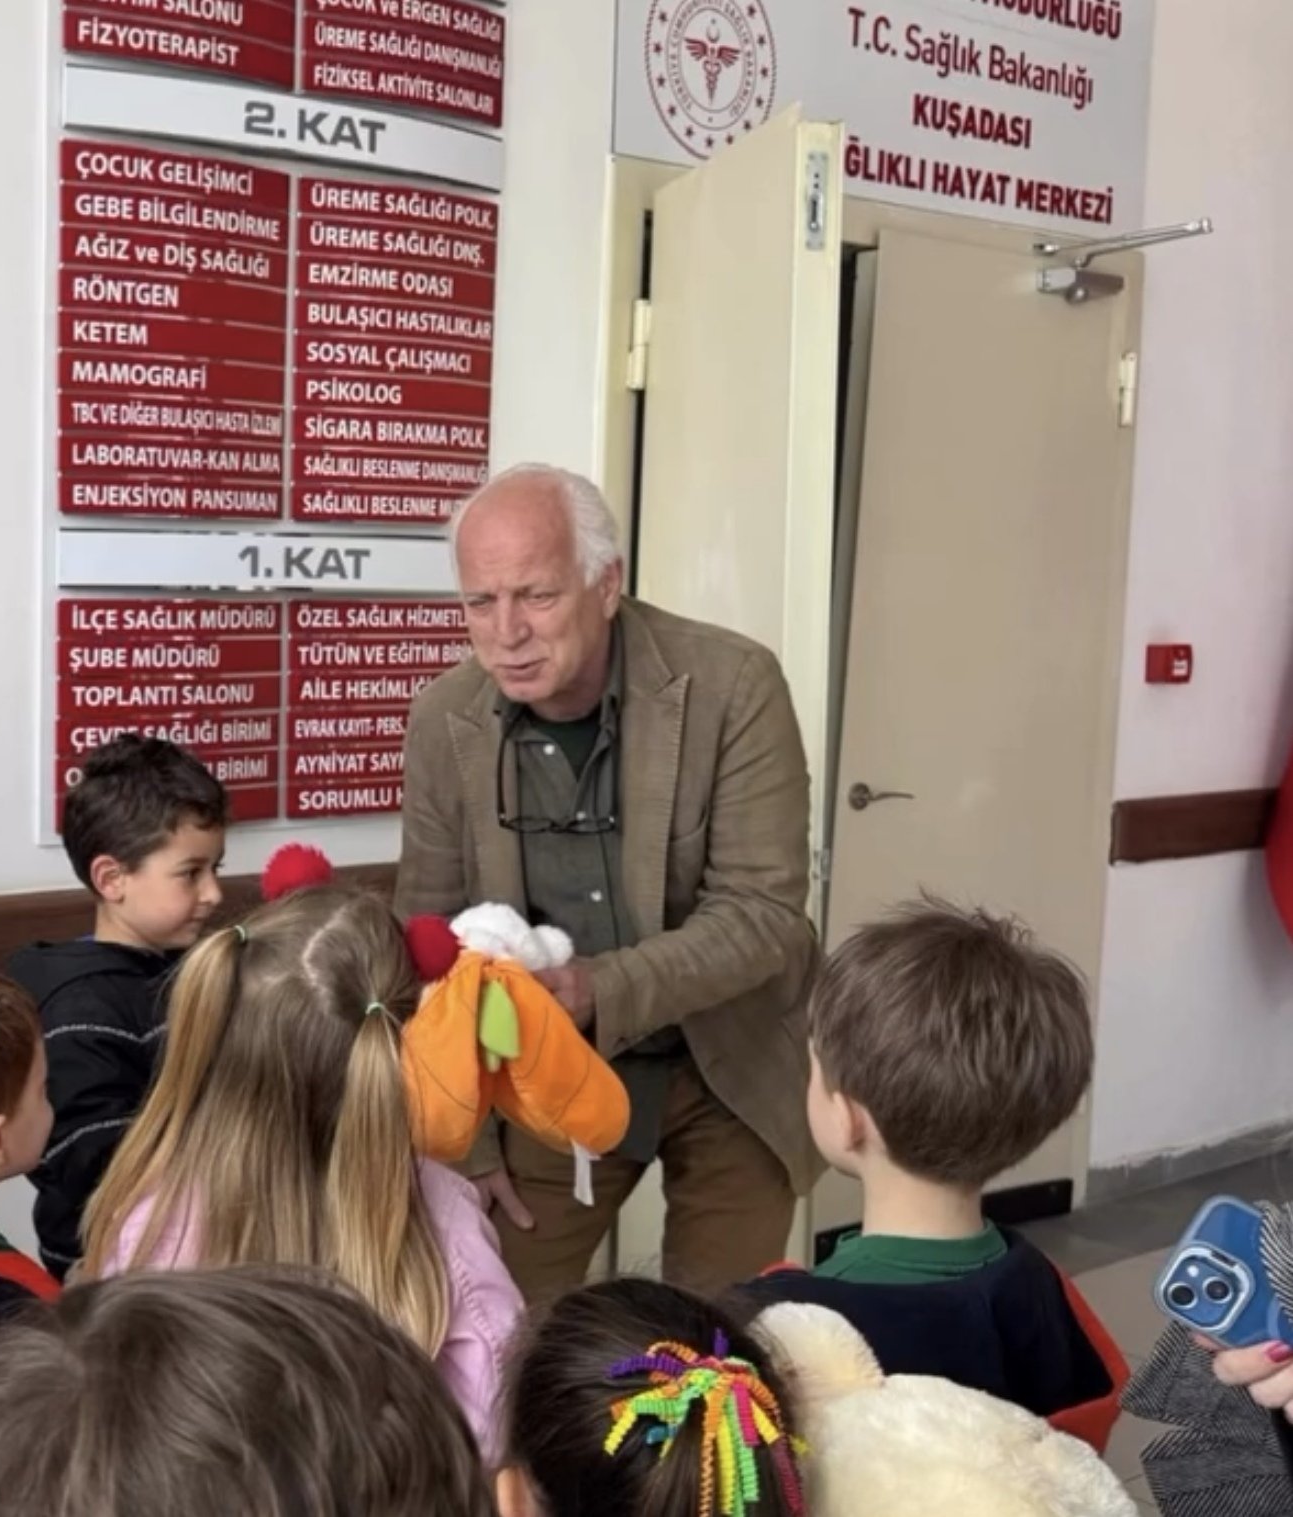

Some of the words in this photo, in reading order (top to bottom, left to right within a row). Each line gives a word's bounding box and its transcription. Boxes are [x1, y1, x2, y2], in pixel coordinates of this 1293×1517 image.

[163, 0, 244, 27] SALONU
[380, 0, 399, 18] ve
[402, 0, 450, 28] ERGEN
[453, 10, 501, 42] SAĞLIĞI
[982, 0, 1122, 40] DÜRLÜĞÜ
[77, 17, 240, 67] FİZYOTERAPİST
[314, 21, 366, 52] ÜREME
[369, 30, 422, 60] SAĞLIĞI
[848, 8, 897, 56] T.C.
[904, 24, 981, 78] Sağlık
[988, 44, 1094, 110] Bakanlığı
[313, 61, 374, 92] FİZİKSEL
[376, 72, 434, 101] AKTİVİTE
[243, 101, 286, 138] 2.
[296, 109, 387, 154] KAT
[912, 93, 1033, 149] KUŞADASI
[75, 151, 155, 181] ÇOCUK
[159, 161, 253, 196] GELİŞİMCİ
[843, 135, 927, 191] ĞLIKLI
[932, 161, 1011, 206] HAYAT
[1015, 177, 1114, 224] MERKEZİ
[75, 194, 134, 220] GEBE
[139, 197, 281, 241] BİLGİLENDİRME
[312, 182, 381, 213] ÜREME
[385, 192, 452, 221] SAĞLIĞI
[455, 205, 495, 230] POLK.
[75, 232, 130, 261] AĞIZ
[134, 245, 159, 264] ve
[163, 240, 197, 273] DİŞ
[200, 249, 270, 278] SAĞLIĞI
[310, 221, 379, 251] ÜREME
[382, 230, 451, 258] SAĞLIĞI
[73, 274, 180, 308] RÖNTGEN
[309, 262, 399, 291] EMZİRME
[402, 273, 454, 299] ODASI
[73, 320, 148, 346] KETEM
[308, 303, 392, 332] BULAŞICI
[396, 310, 492, 340] HASTALIKLAR
[307, 341, 381, 367] SOSYAL
[385, 347, 472, 375] ÇALIŞMACI
[72, 360, 206, 390] MAMOGRAFİ
[306, 376, 402, 405] PSİKOLOG
[72, 402, 98, 424] TBC
[101, 403, 118, 425] VE
[120, 400, 160, 427] DİĞER
[216, 409, 249, 433] HASTA
[305, 414, 373, 441] SİGARA
[377, 420, 447, 445] BIRAKMA
[450, 426, 487, 449] POLK.
[72, 443, 240, 472] LABORATUVAR-KAN
[242, 452, 281, 474] ALMA
[304, 453, 360, 478] SAĞLIKLI
[362, 458, 421, 480] BESLENME
[72, 481, 186, 508] ENJEKSİYON
[192, 488, 278, 512] PANSUMAN
[303, 490, 369, 515] SAĞLIKLI
[371, 495, 437, 517] BESLENME
[238, 546, 274, 579] 1.
[285, 547, 371, 580] KAT
[72, 604, 119, 635] İLÇE
[123, 604, 196, 630] SAĞLIK
[200, 605, 276, 628] MÜDÜRÜ
[297, 604, 343, 628] ÖZEL
[347, 604, 404, 628] SAĞLIK
[407, 605, 467, 628] HİZMETL
[69, 647, 127, 674] ŞUBE
[132, 643, 221, 668] MÜDÜRÜ
[297, 642, 360, 666] TÜTÜN
[364, 645, 385, 664] VE
[388, 640, 439, 664] EĞİTİM
[72, 685, 177, 706] TOPLANTI
[182, 683, 255, 705] SALONU
[300, 676, 343, 700] AİLE
[346, 675, 433, 699] HEKİMLİĞ
[143, 720, 218, 747] SAĞLIĞI
[221, 717, 272, 743] BİRİMİ
[295, 718, 337, 738] EVRAK
[217, 754, 268, 781] BİRİMİ
[295, 749, 367, 775] AYNİYAT
[299, 786, 393, 811] SORUMLU
